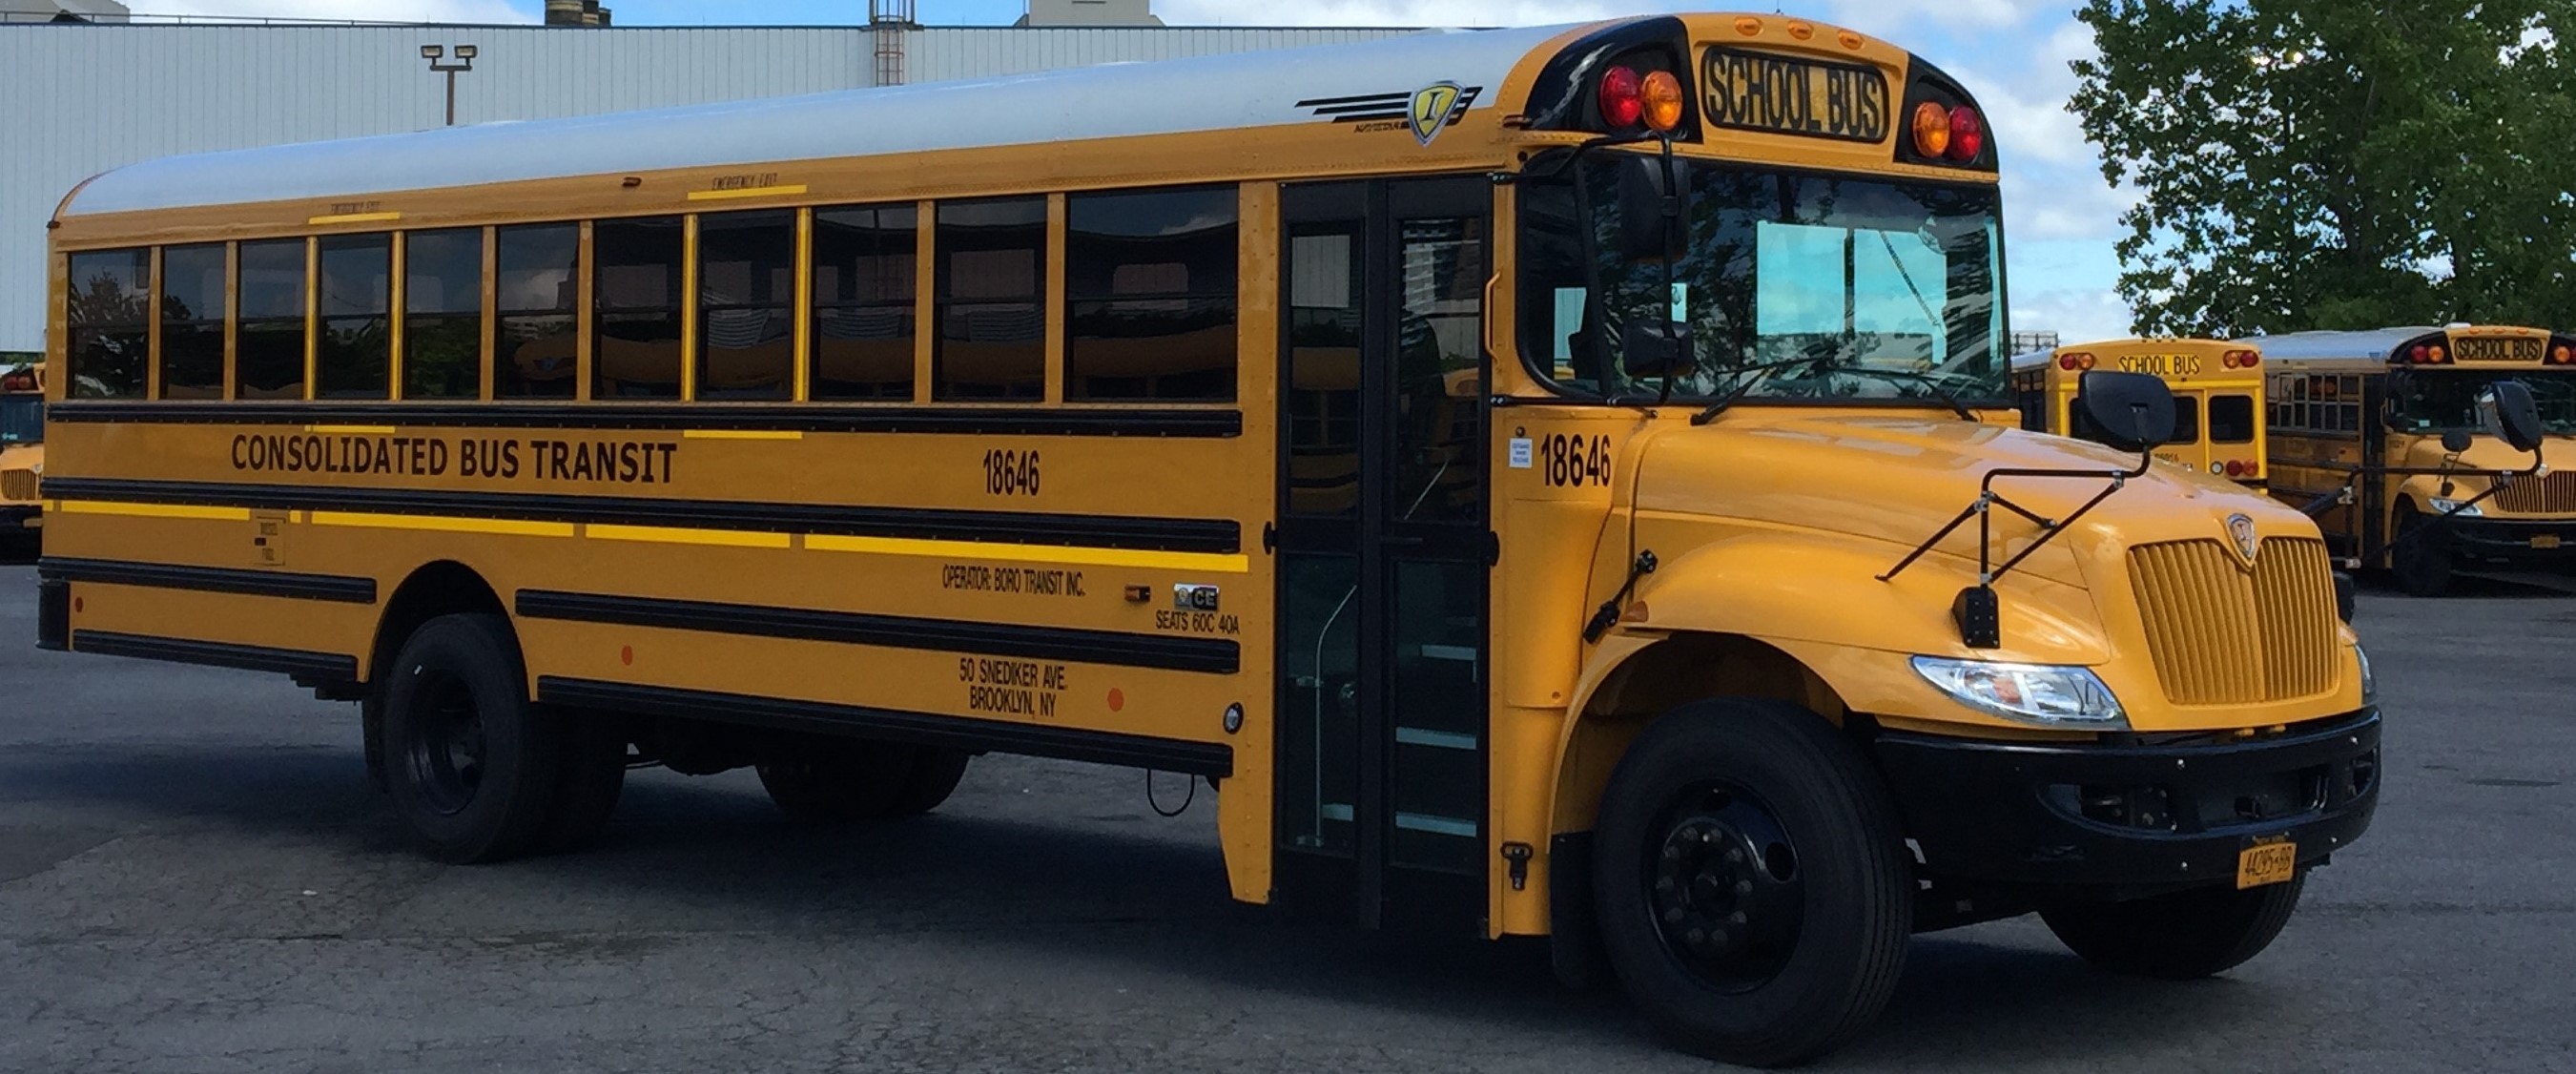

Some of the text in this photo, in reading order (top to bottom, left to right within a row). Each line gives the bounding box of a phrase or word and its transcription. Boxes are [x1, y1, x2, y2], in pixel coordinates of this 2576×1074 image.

[1709, 52, 1879, 138] SCHOOL BUS
[2118, 355, 2200, 375] SCHOOL BUS
[2458, 339, 2540, 359] SCHOOL BUS
[231, 434, 677, 484] CONSOLIDATED BUS TRANSIT
[983, 449, 1040, 496] 18646
[1540, 433, 1611, 487] 18646
[942, 564, 1086, 597] OPERATOR: BORO TRANSIT INC.
[1194, 589, 1216, 606] CE
[1155, 609, 1240, 635] SEATS 60C 40A
[959, 657, 975, 682] 50
[979, 658, 1039, 688] SNEDIKER
[970, 685, 1057, 719] BROOKLYN, NY
